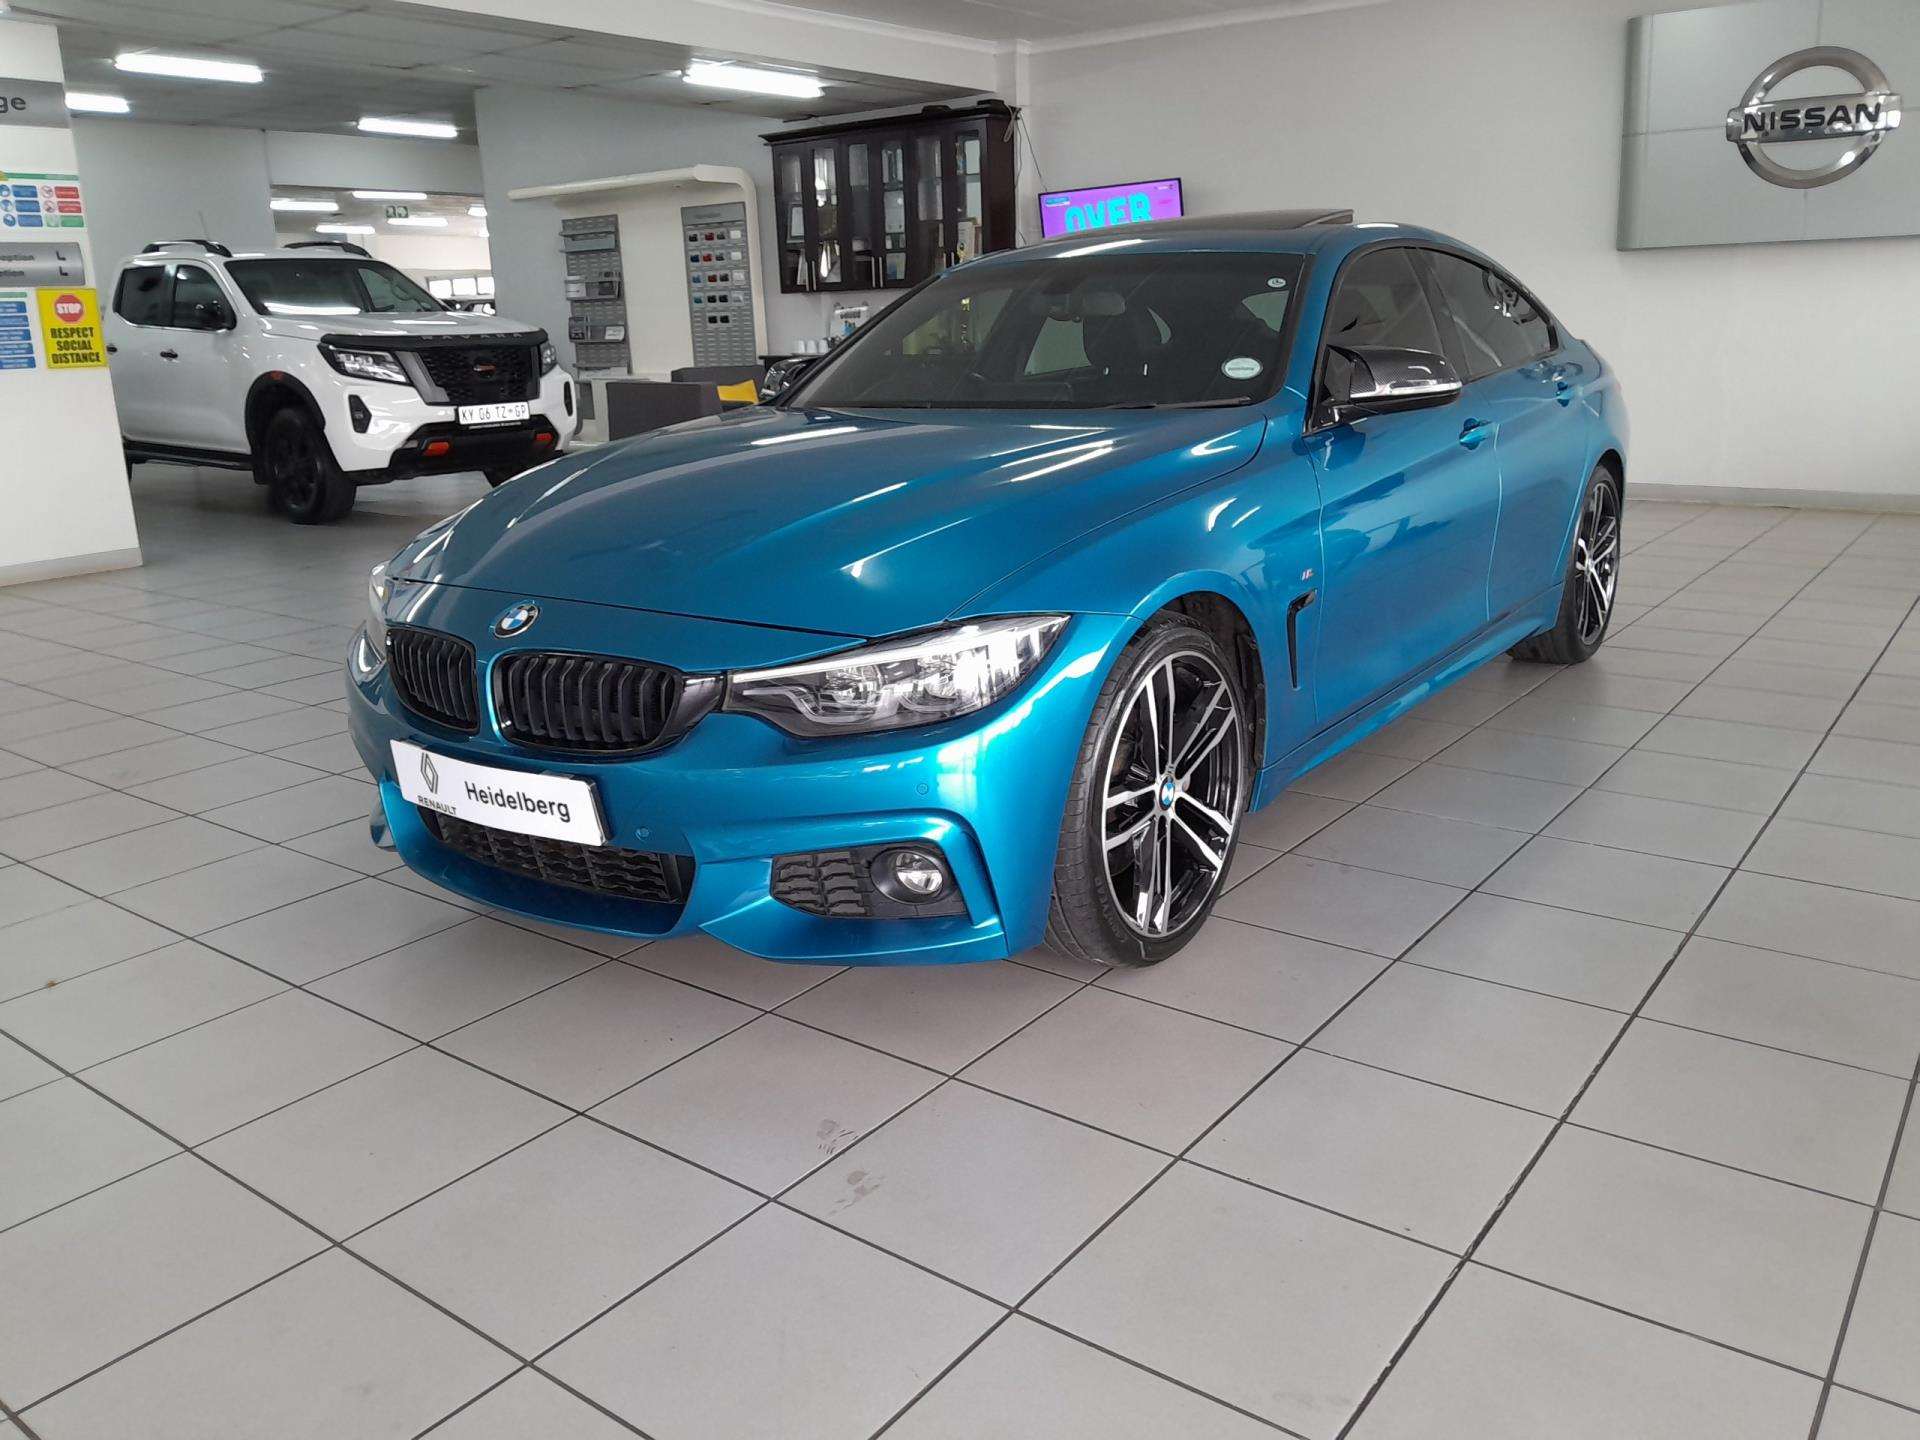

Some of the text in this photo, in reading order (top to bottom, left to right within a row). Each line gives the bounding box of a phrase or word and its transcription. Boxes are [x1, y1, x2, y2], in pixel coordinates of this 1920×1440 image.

[1743, 102, 1881, 132] NISSAN
[1065, 191, 1153, 233] OVER
[56, 302, 82, 314] STOP
[50, 326, 94, 339] RESPECT
[56, 340, 92, 351] SOCIAL
[51, 352, 101, 364] DISTANCE
[417, 794, 458, 816] RENAULT
[464, 780, 571, 823] Heidelberg
